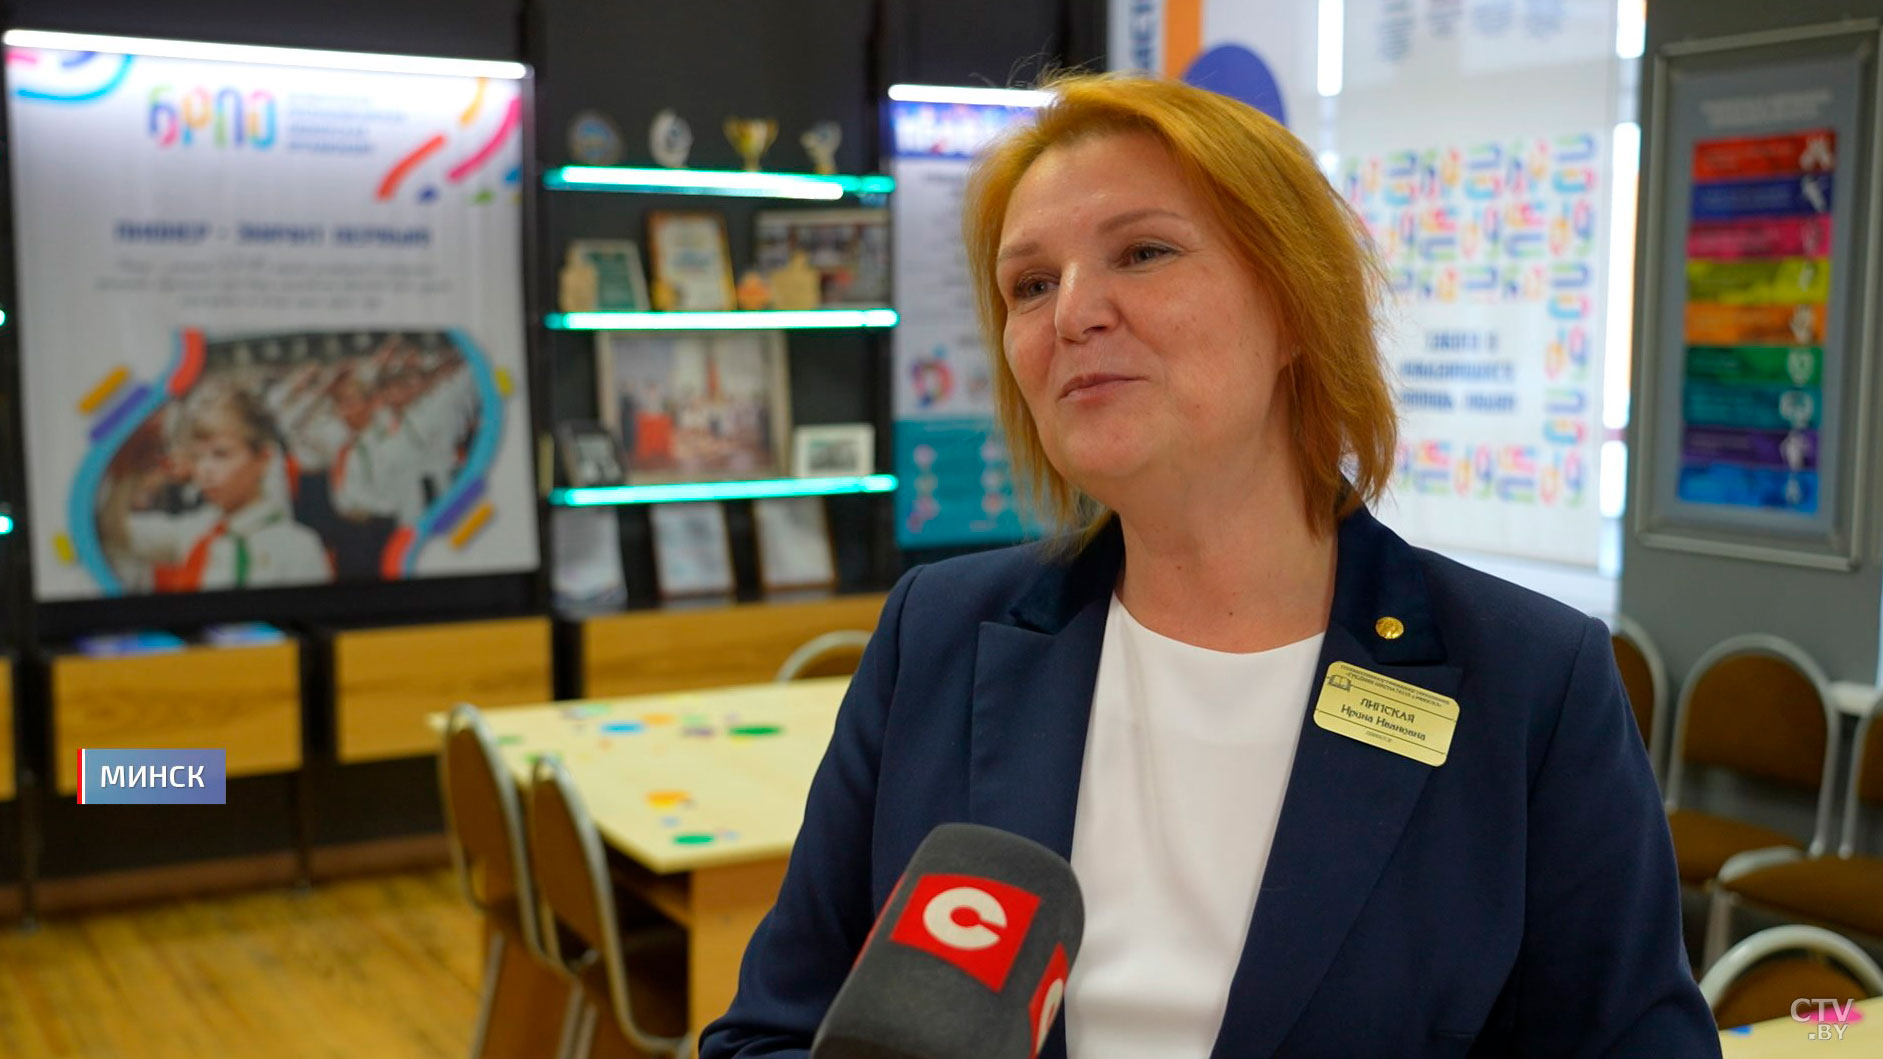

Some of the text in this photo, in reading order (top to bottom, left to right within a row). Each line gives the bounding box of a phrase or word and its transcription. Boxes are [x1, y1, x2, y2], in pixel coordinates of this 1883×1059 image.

[1340, 704, 1374, 723] Ирина
[1376, 716, 1426, 741] Ивановна
[1360, 697, 1415, 723] ЛИПСКАЯ
